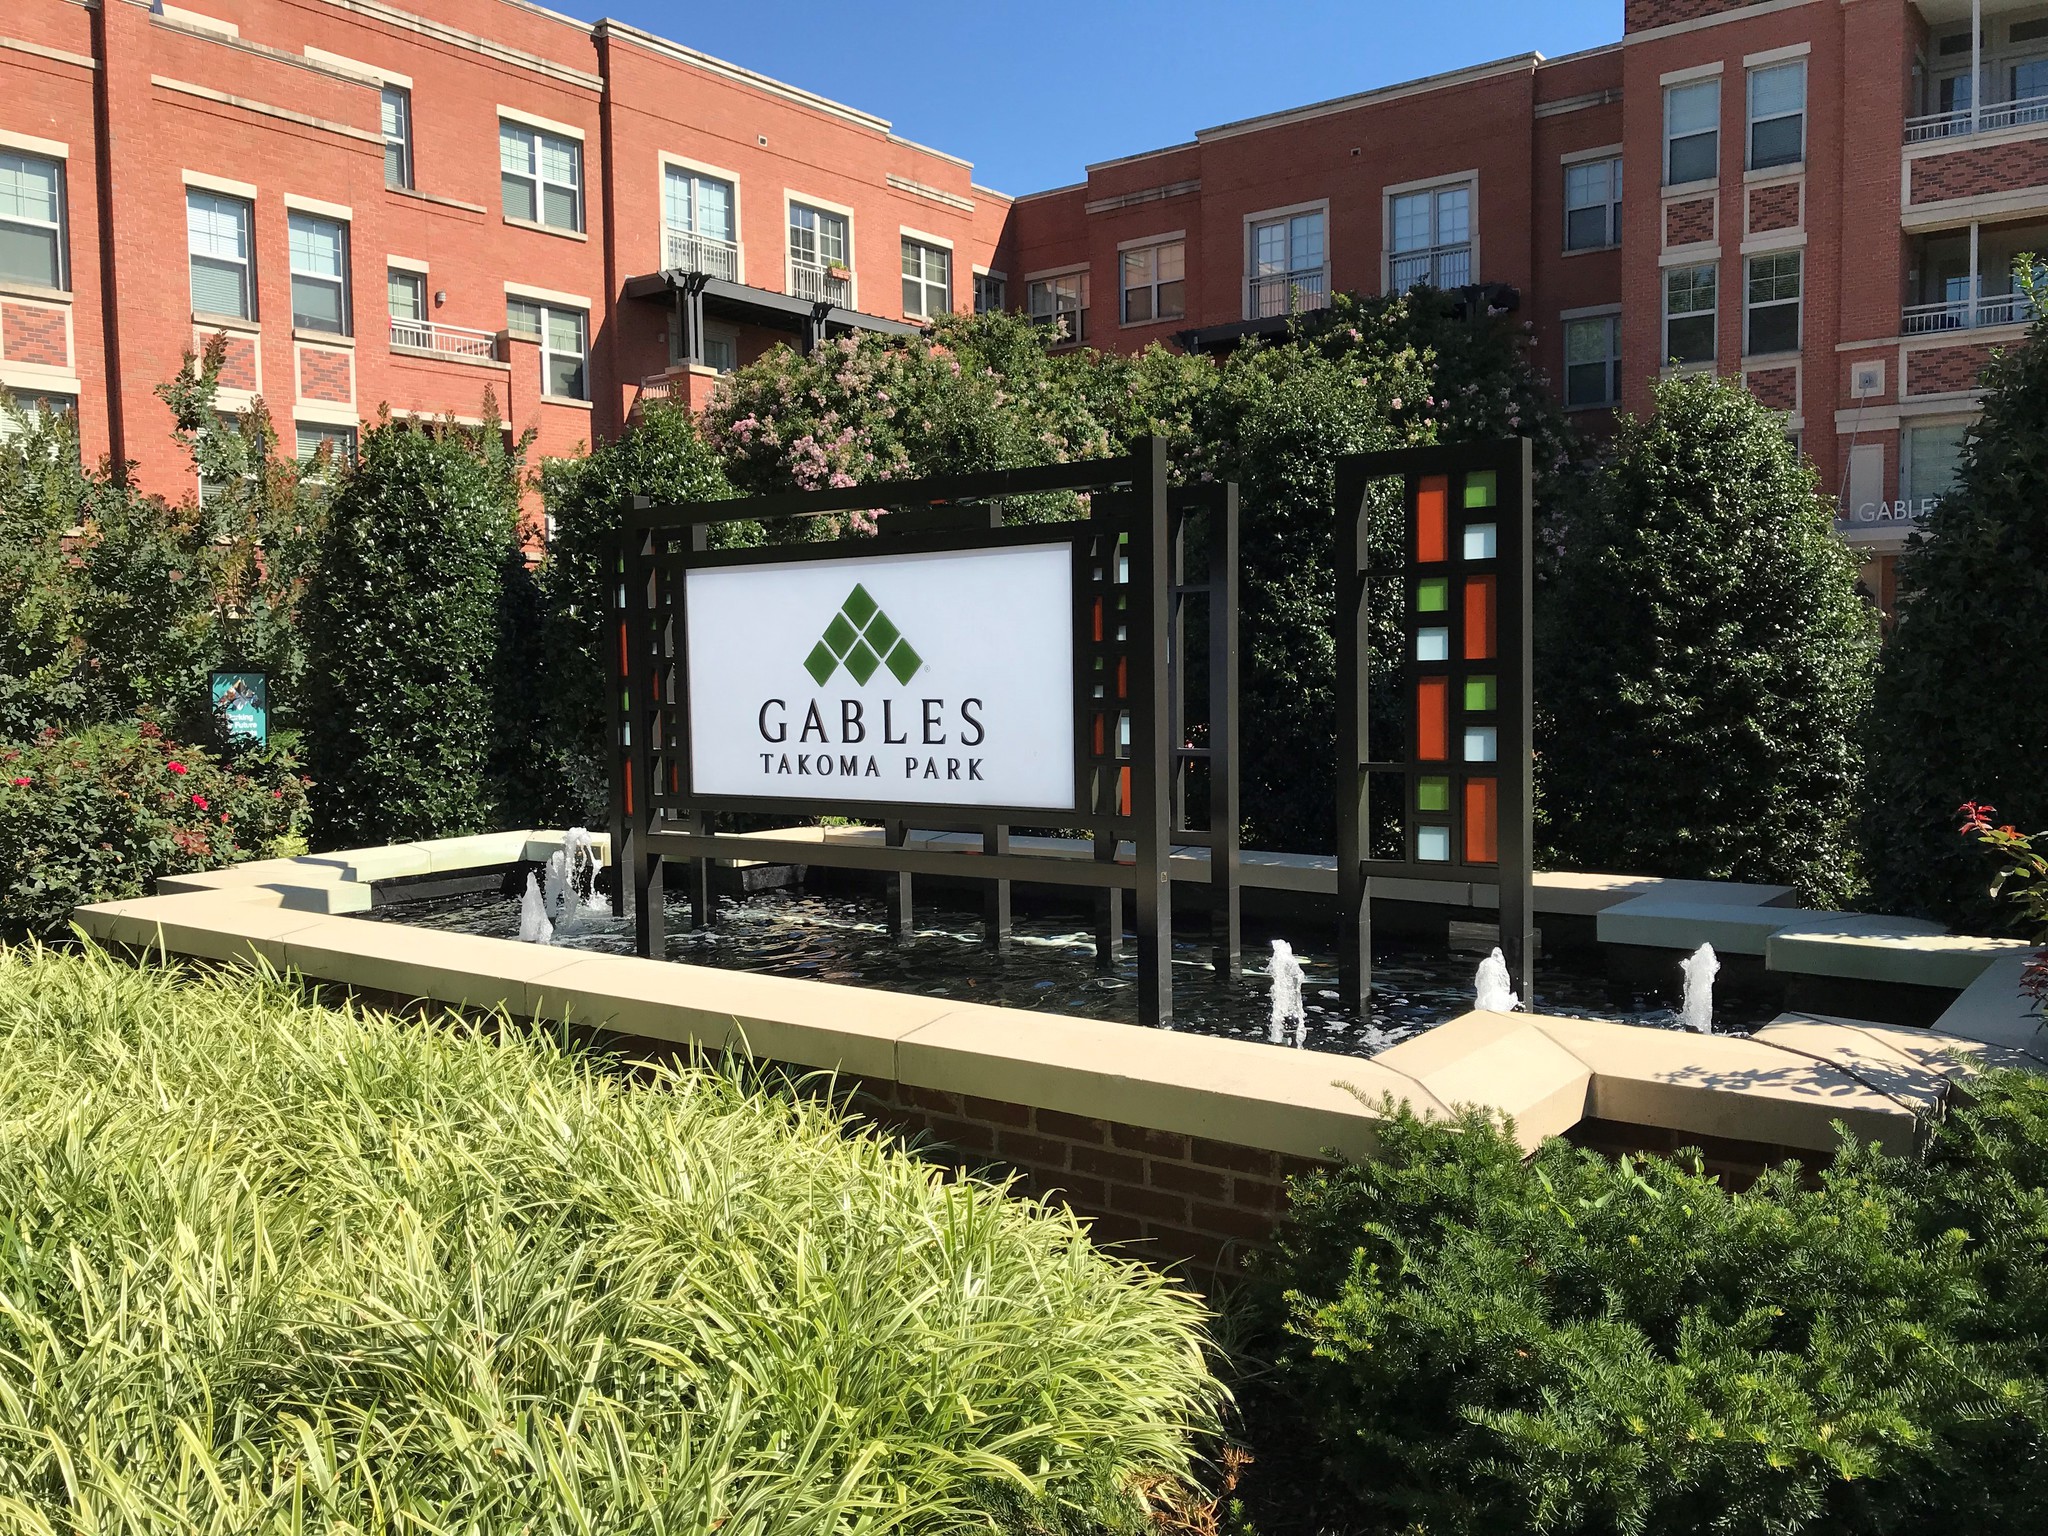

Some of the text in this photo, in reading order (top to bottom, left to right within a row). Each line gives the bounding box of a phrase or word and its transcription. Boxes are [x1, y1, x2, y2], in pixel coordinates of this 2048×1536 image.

[1858, 498, 1943, 522] GABLE
[758, 697, 985, 747] GABLES
[759, 753, 985, 781] TAKOMA PARK
